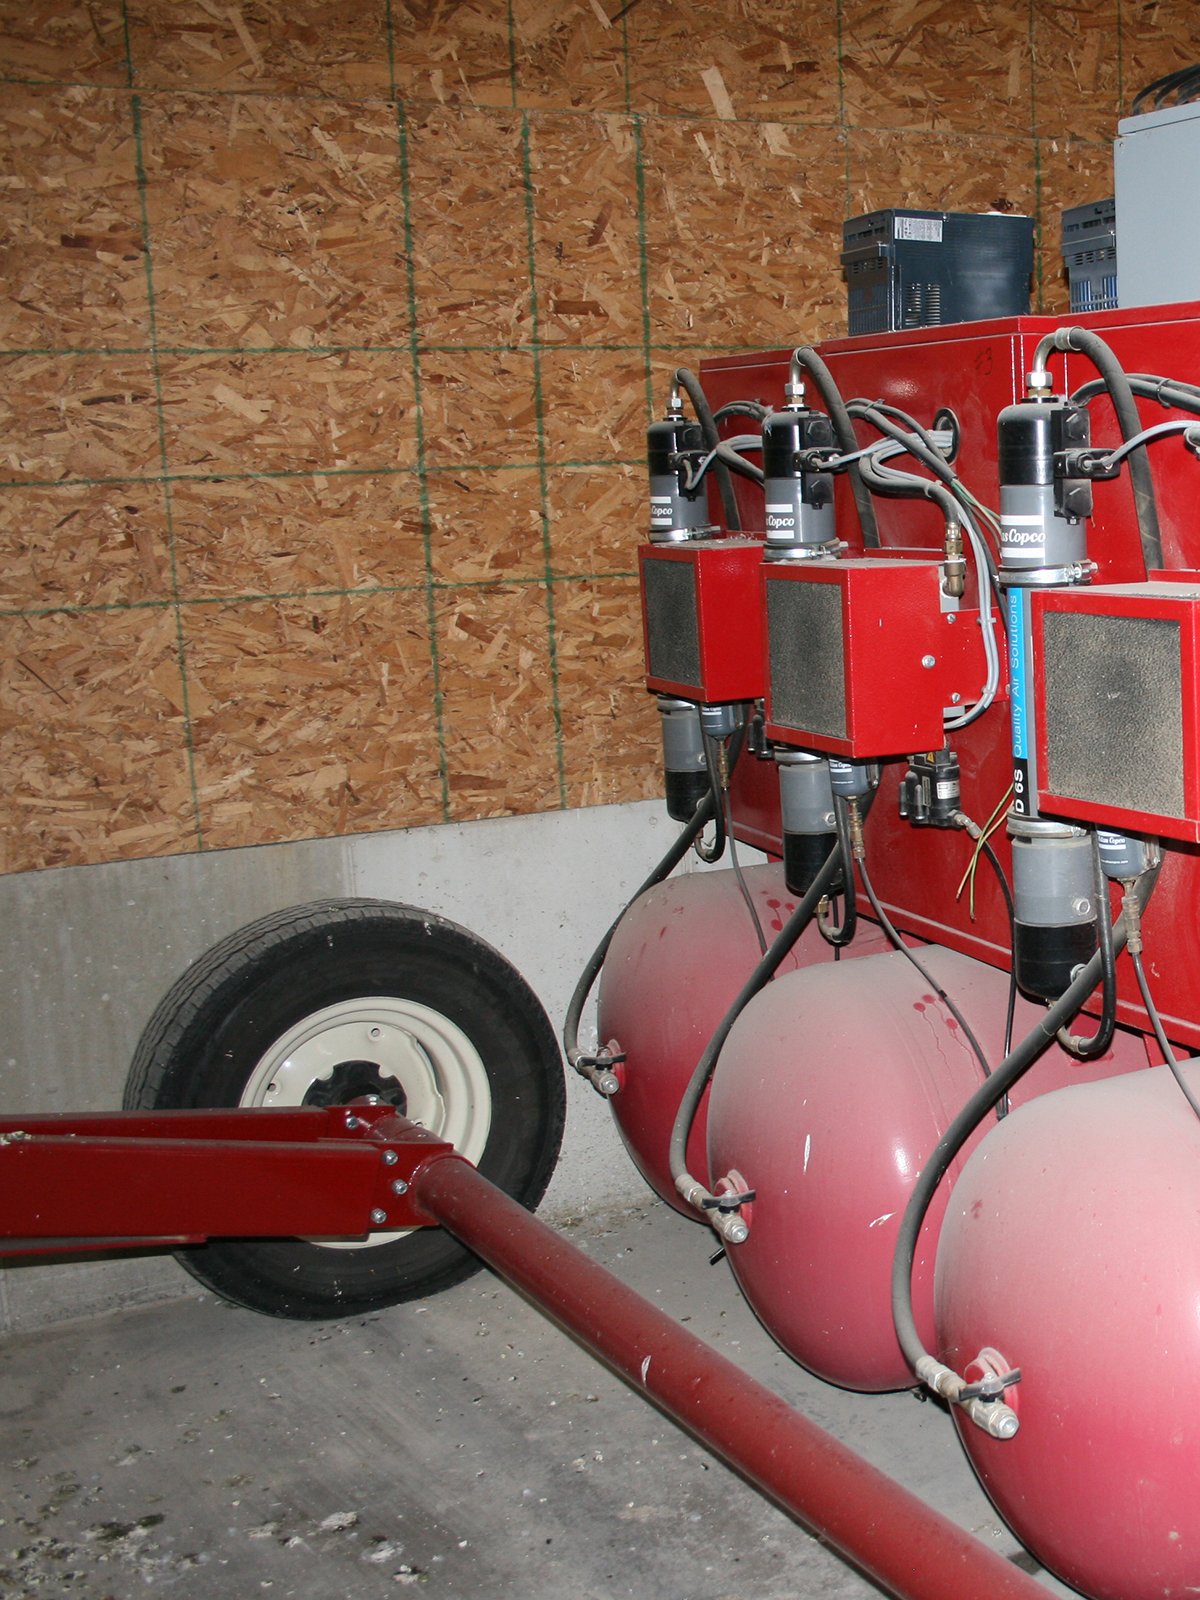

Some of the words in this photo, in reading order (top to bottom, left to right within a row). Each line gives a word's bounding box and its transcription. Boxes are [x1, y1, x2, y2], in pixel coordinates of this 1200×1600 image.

[1010, 594, 1019, 669] Solutions
[1012, 674, 1020, 697] Air
[1013, 703, 1023, 758] Quality
